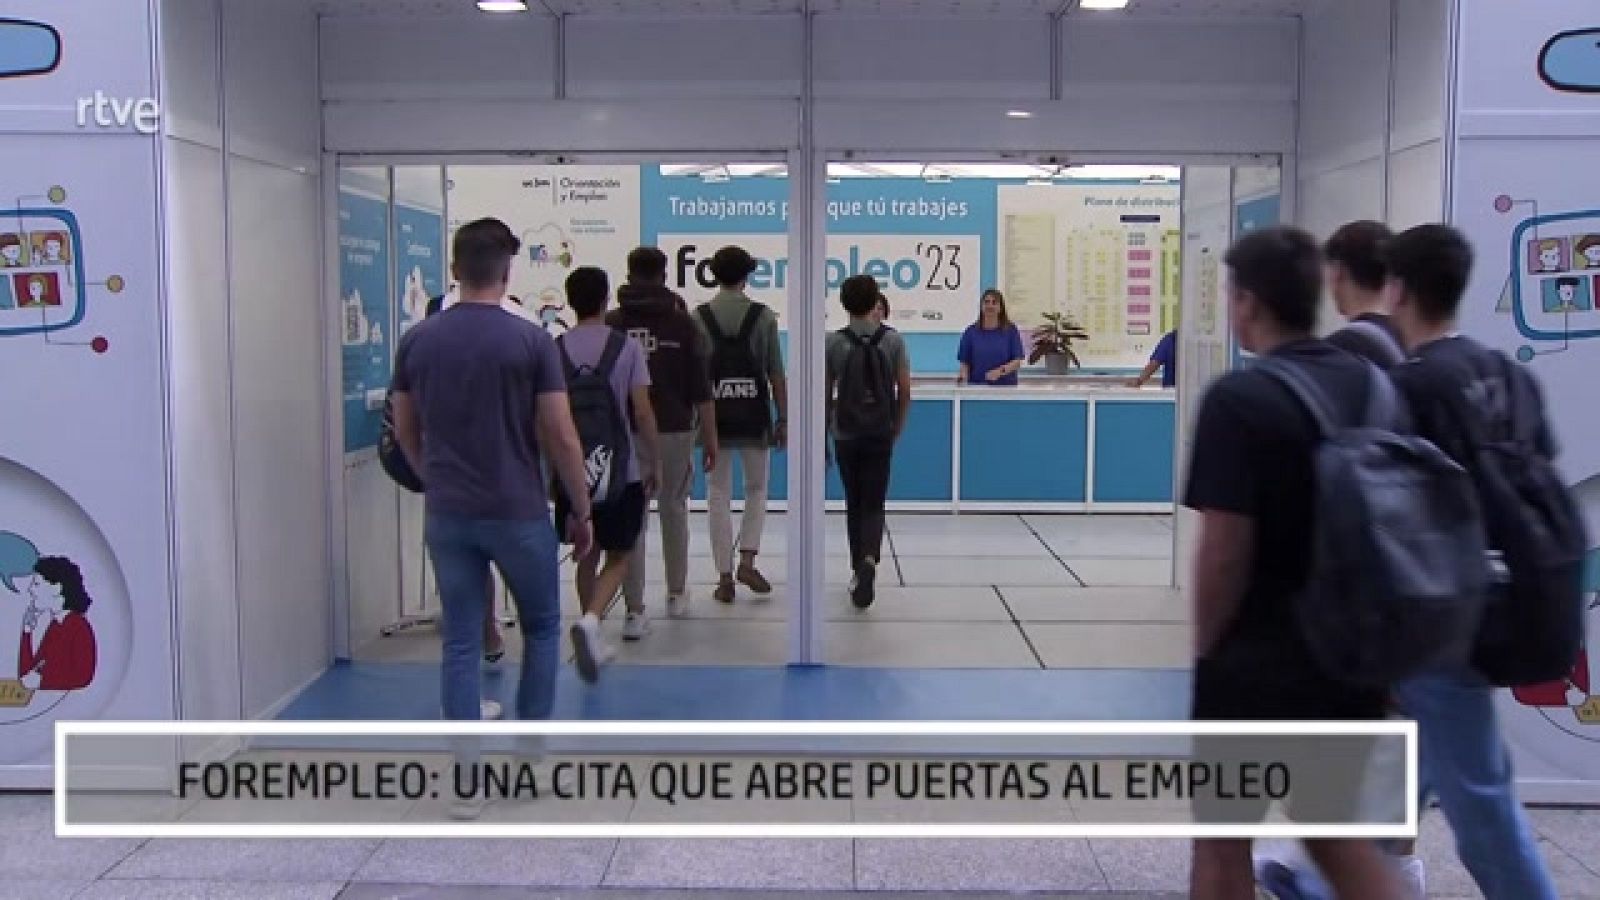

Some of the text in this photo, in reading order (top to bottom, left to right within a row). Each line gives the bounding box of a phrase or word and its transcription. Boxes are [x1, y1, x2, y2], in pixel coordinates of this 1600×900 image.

[669, 195, 776, 220] Trabajamos
[827, 200, 861, 220] que
[867, 197, 886, 216] tú
[891, 197, 968, 220] trabajes
[711, 378, 758, 399] VANS
